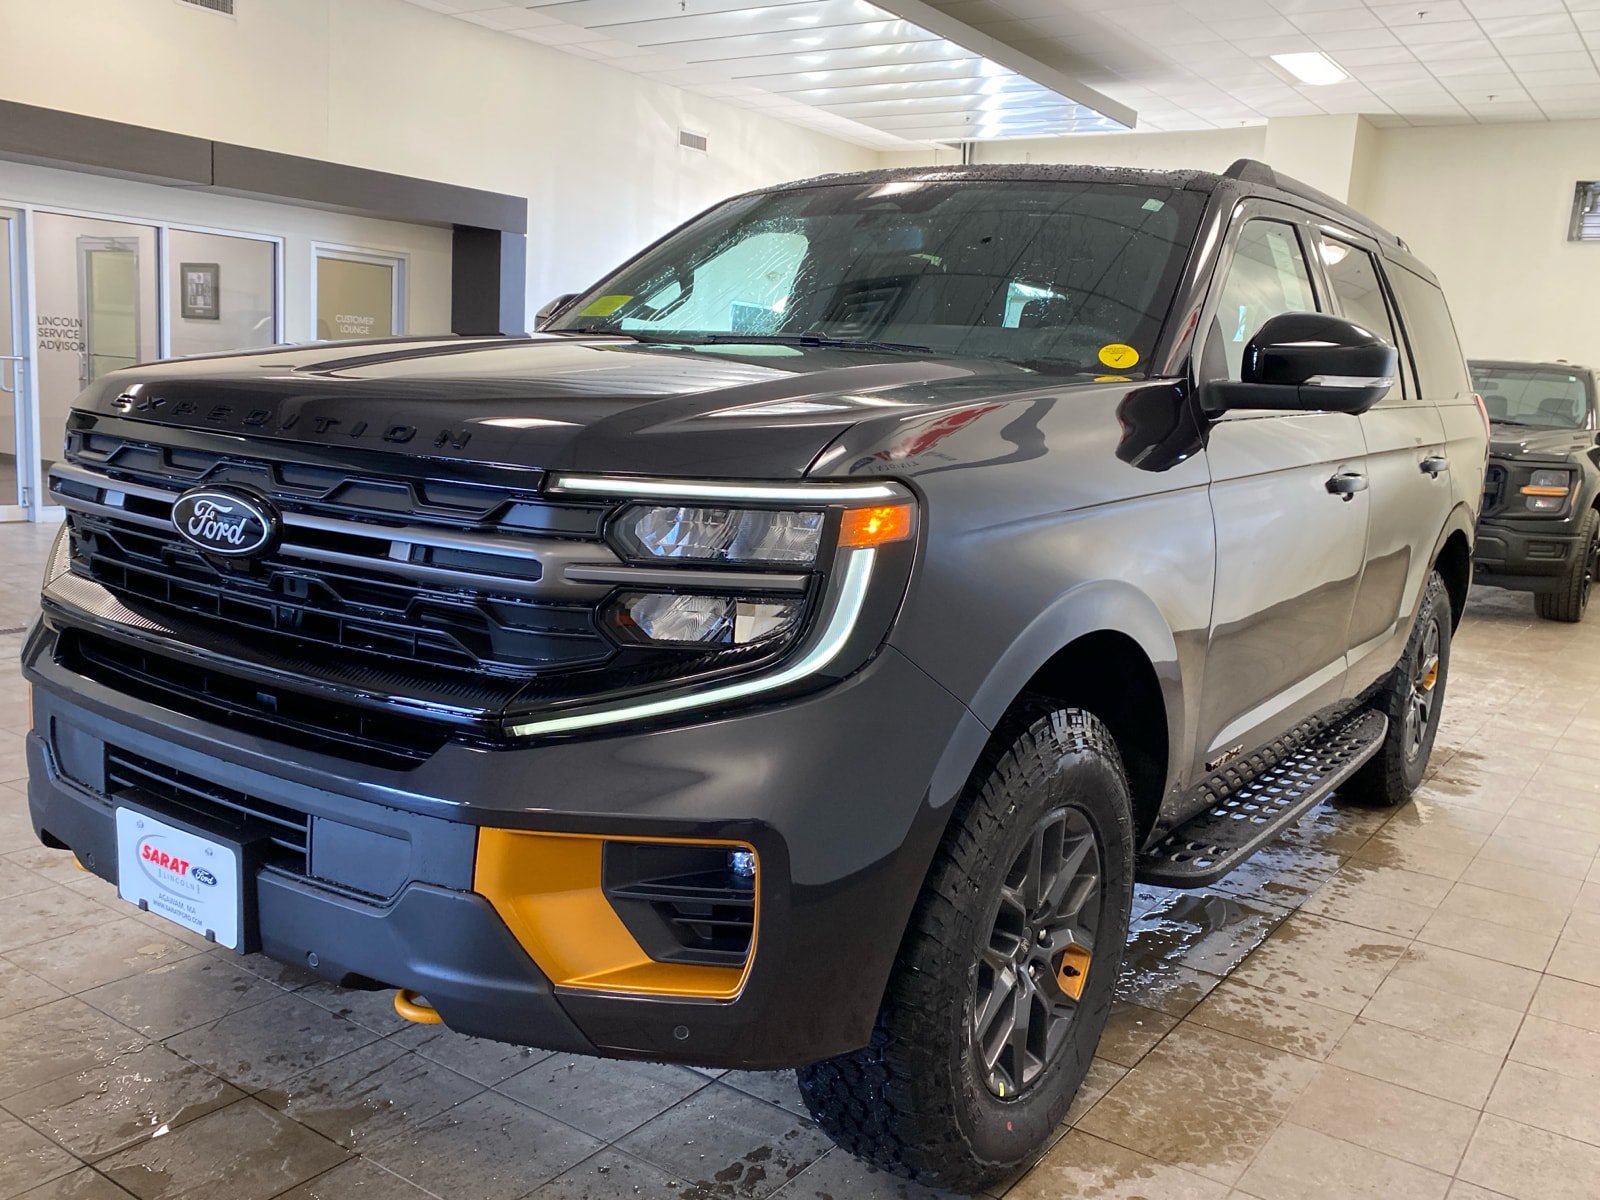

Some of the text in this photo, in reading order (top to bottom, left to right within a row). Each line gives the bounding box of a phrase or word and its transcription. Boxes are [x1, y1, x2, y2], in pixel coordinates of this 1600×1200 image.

[37, 316, 83, 328] LINCOLN
[335, 314, 375, 324] CUSTOMER
[37, 328, 80, 339] SERVICE
[340, 325, 369, 335] LOUNGE
[39, 340, 86, 352] ADVISOR
[110, 393, 473, 450] EXPEDITION
[188, 500, 247, 545] Ford
[142, 844, 214, 885] SARAT Ford
[186, 904, 196, 914] MA
